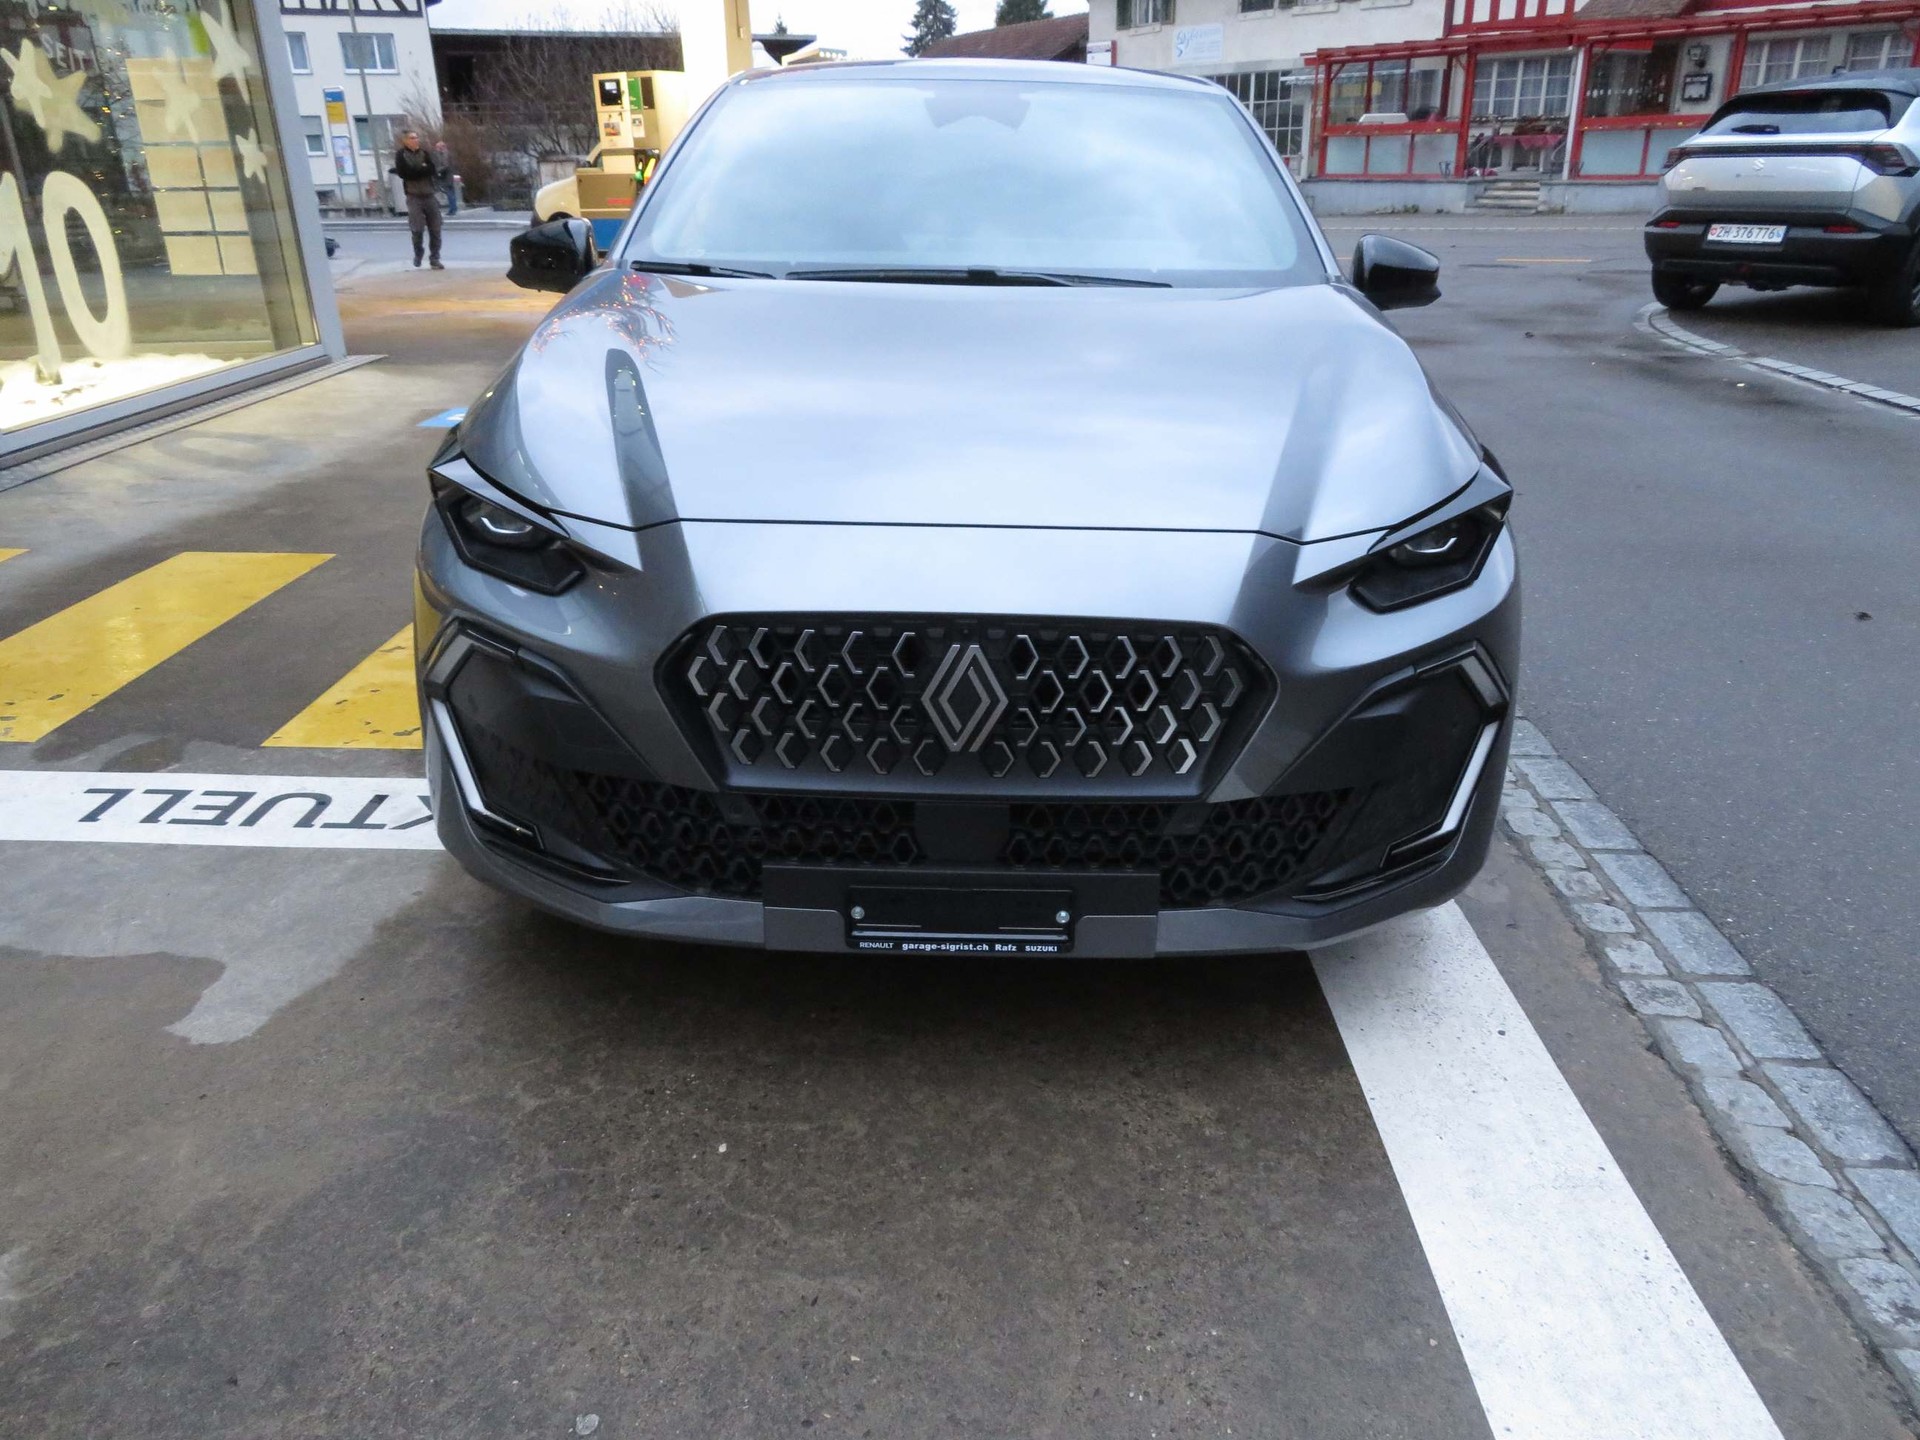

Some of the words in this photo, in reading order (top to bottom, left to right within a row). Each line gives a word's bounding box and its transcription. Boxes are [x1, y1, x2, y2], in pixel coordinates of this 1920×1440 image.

[1733, 227, 1777, 239] 376776
[902, 943, 989, 952] garage-sigrist.ch
[995, 944, 1017, 952] Rafz
